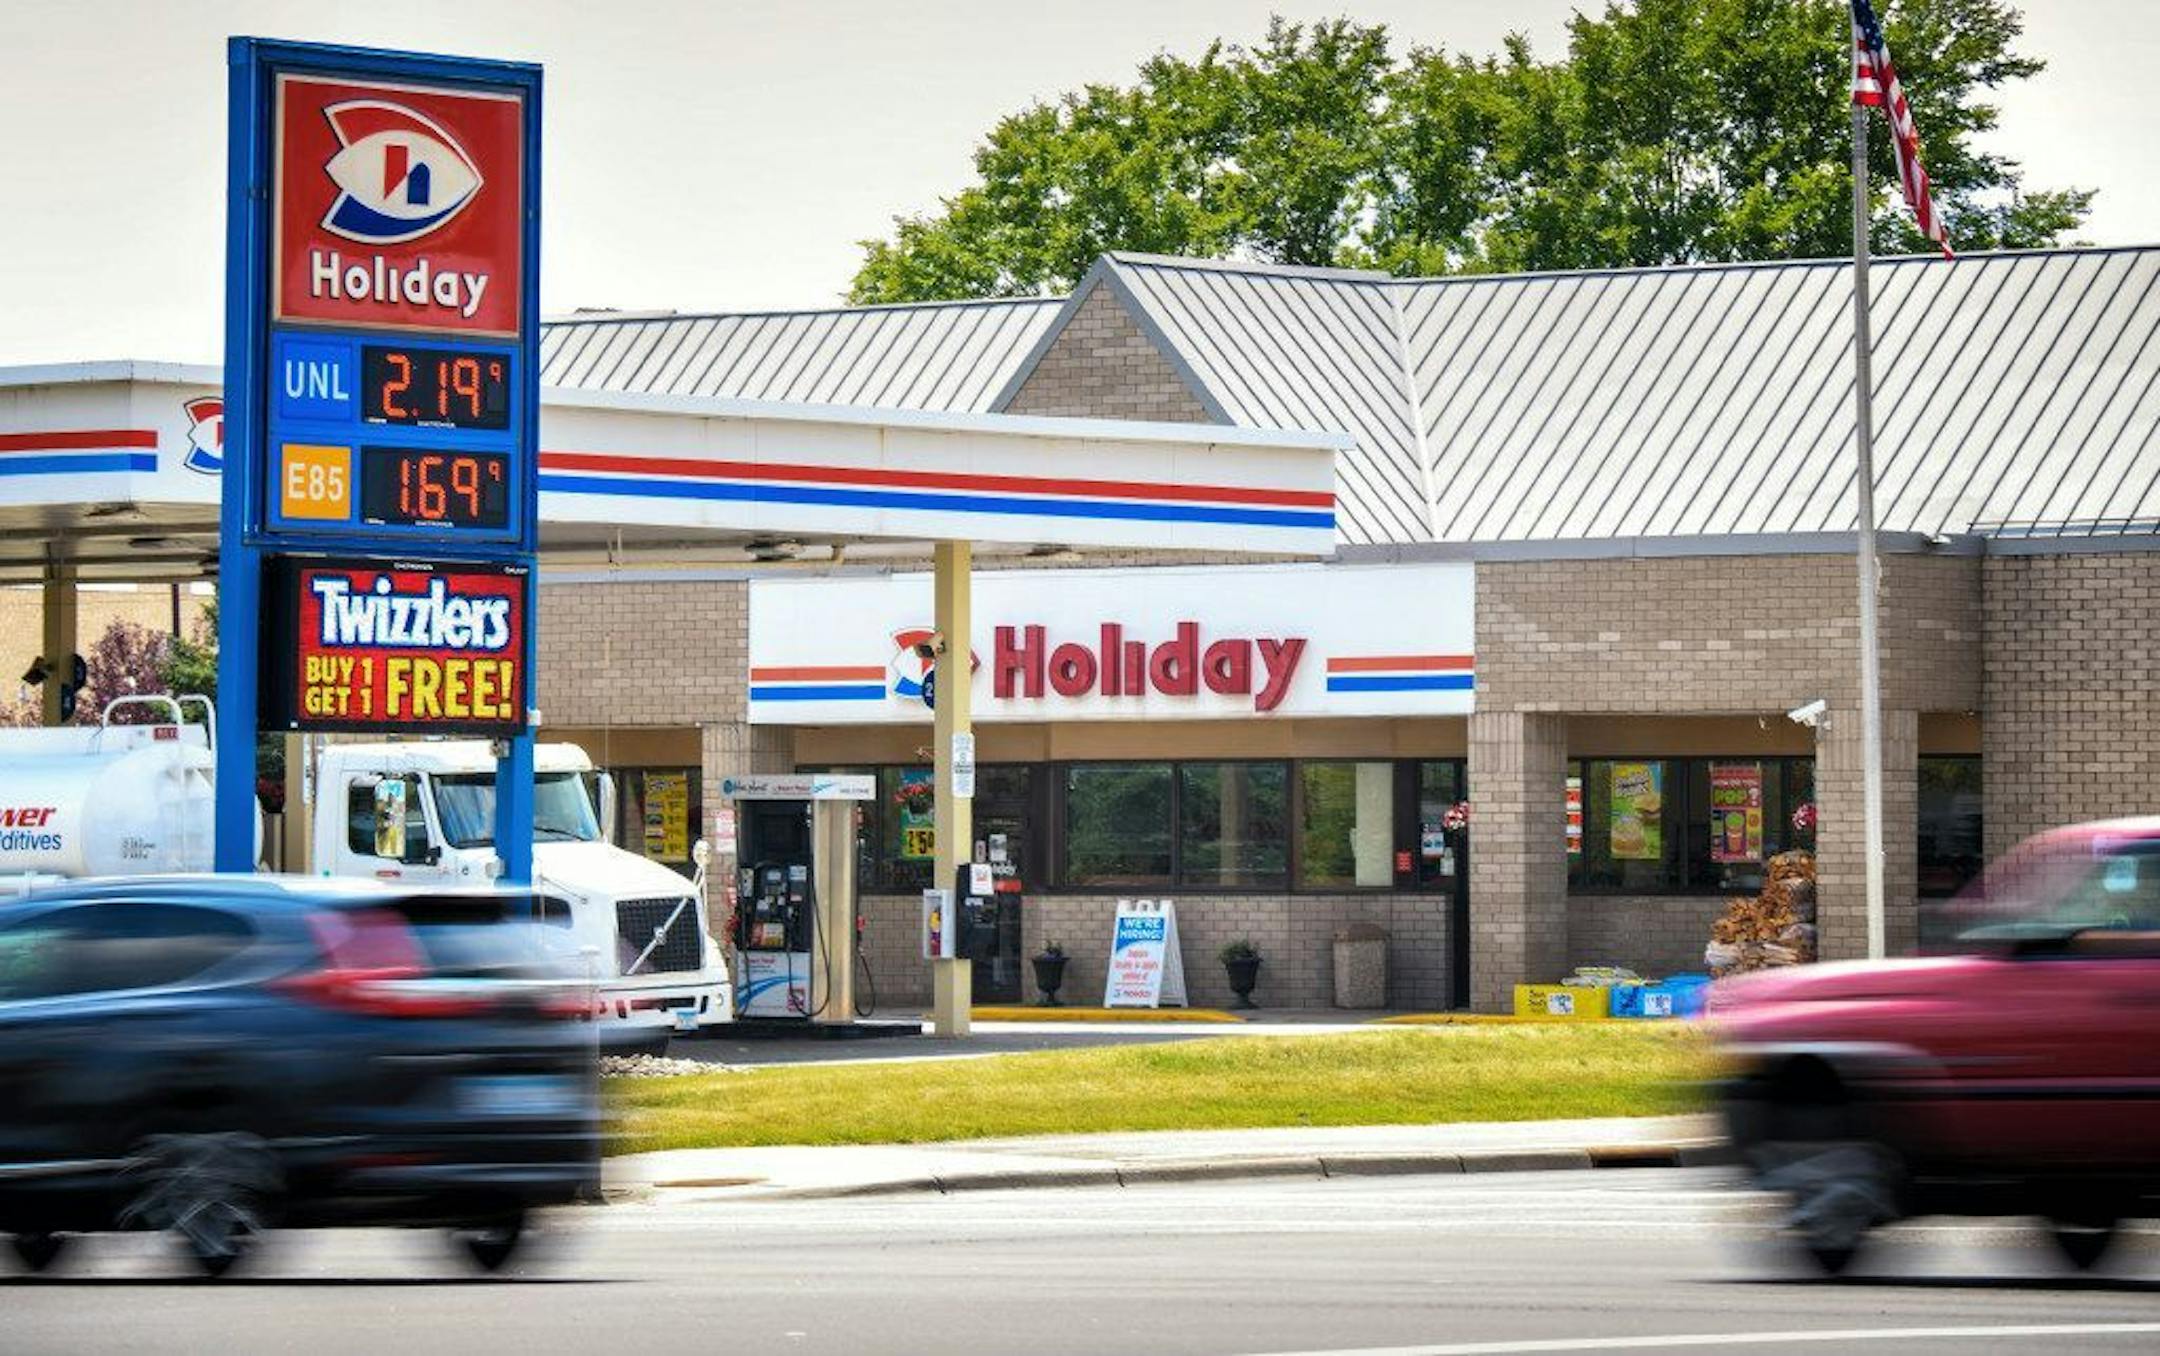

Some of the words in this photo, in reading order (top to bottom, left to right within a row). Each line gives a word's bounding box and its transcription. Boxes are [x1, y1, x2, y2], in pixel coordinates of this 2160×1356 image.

[311, 250, 488, 317] Holiday
[285, 360, 350, 401] UNL
[287, 462, 345, 502] E85
[312, 577, 510, 649] Twizzlers
[306, 656, 354, 686] BUY
[360, 657, 373, 686] 1
[994, 621, 1307, 712] Holiday
[304, 686, 351, 716] GET
[360, 687, 373, 716] 1
[386, 657, 515, 719] FREE!
[0, 830, 61, 850] ditives
